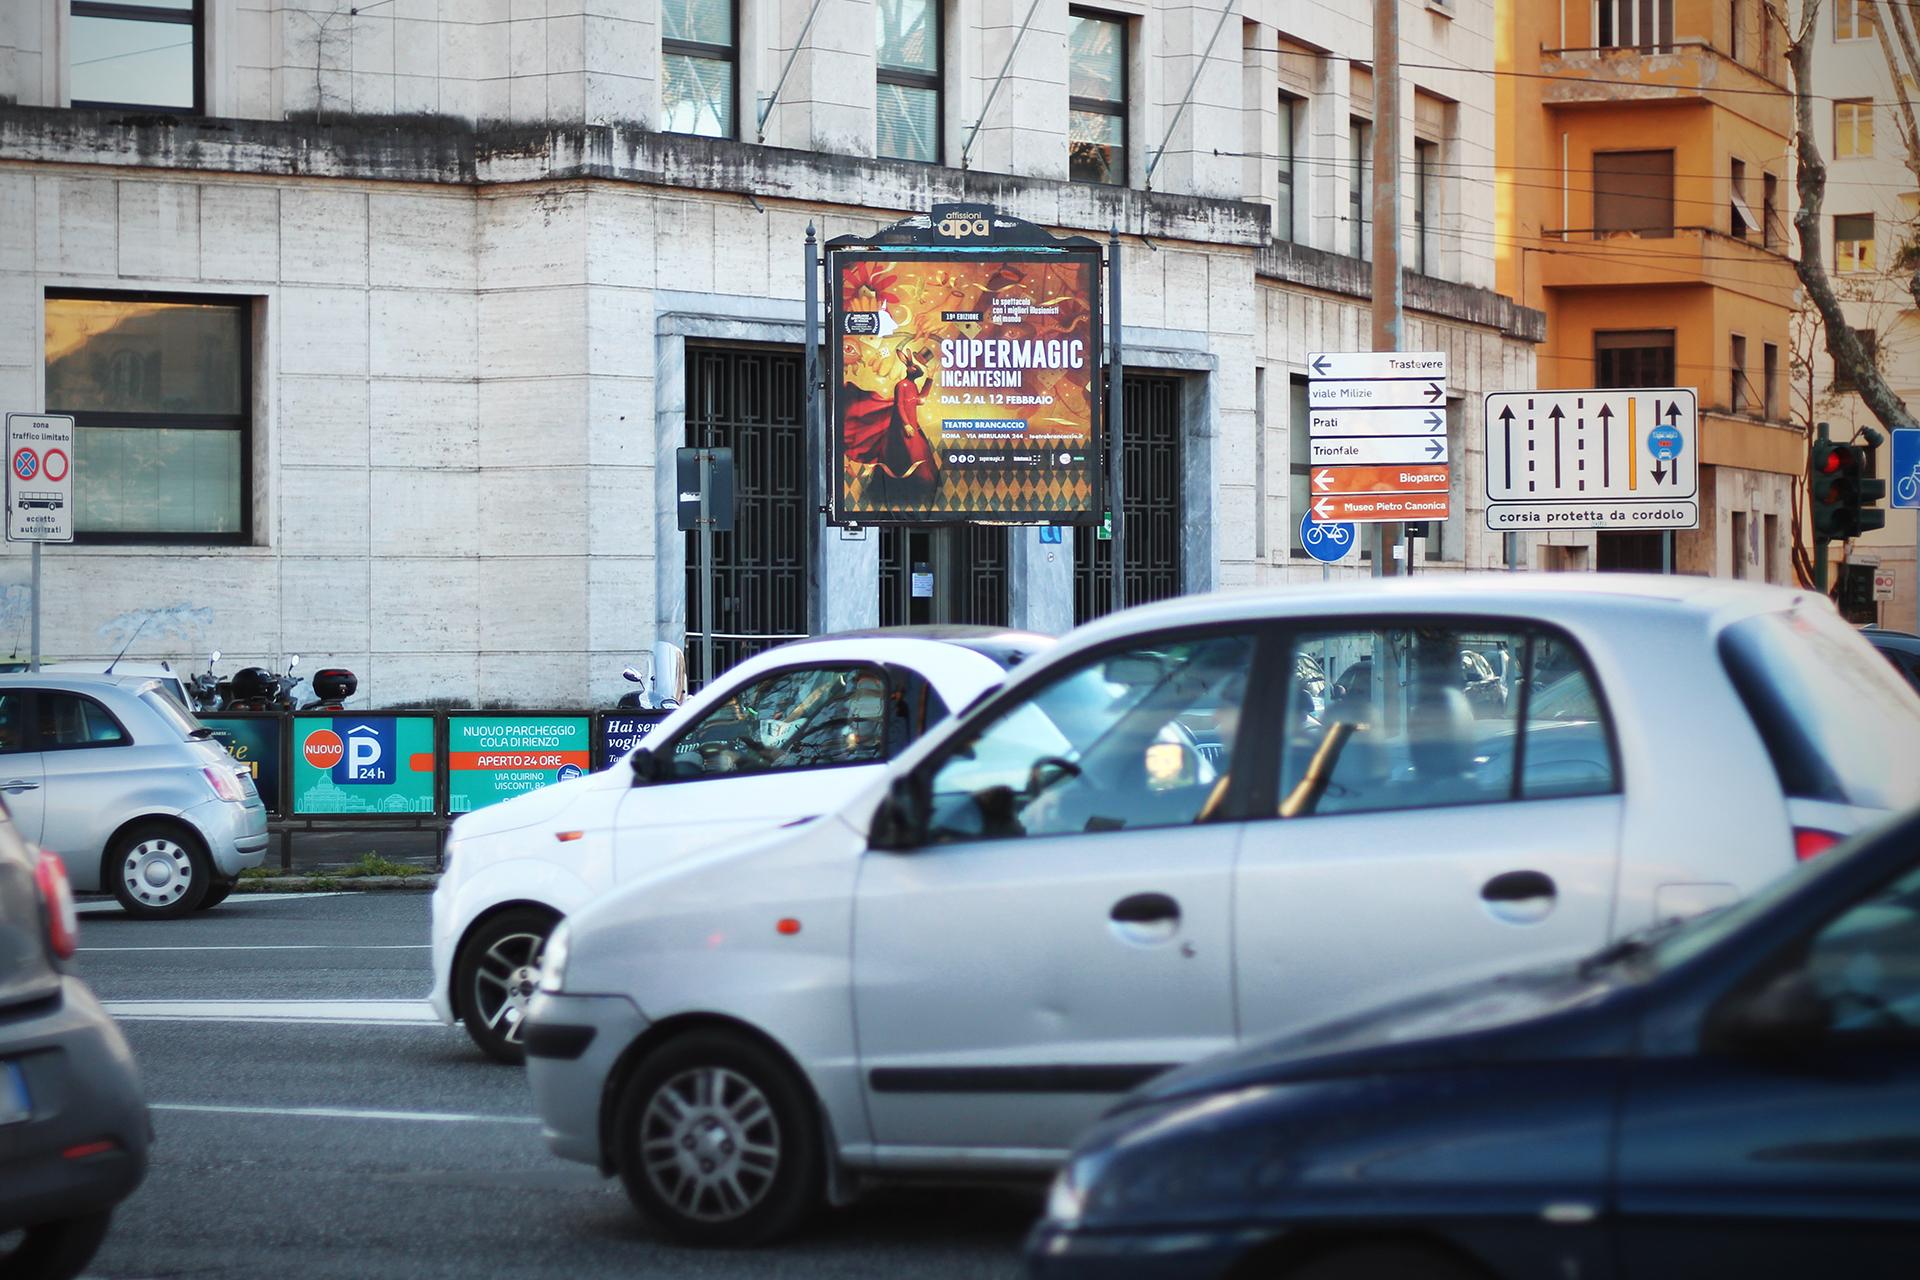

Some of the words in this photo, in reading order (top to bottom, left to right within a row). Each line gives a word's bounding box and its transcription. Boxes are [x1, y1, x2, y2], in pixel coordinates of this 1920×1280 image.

[945, 211, 982, 220] affissioni
[938, 219, 990, 240] apa
[956, 313, 979, 321] EDIZIONE
[941, 339, 1084, 369] SUPERMAGIC
[1389, 359, 1444, 369] Trastevere
[941, 370, 1022, 388] INCANTESIMI
[1312, 388, 1337, 398] viale
[1340, 388, 1373, 398] Milizie
[941, 395, 961, 405] DAL
[963, 393, 971, 405] 2
[974, 395, 986, 405] AL
[989, 393, 1004, 405] 12
[1006, 395, 1054, 405] FEBBRAIO
[944, 421, 973, 429] TEATRO
[975, 421, 1025, 429] BRANCACCIO
[1313, 417, 1338, 428] Prati
[12, 432, 40, 440] traffico
[41, 433, 70, 442] limitato
[1313, 446, 1359, 456] Trionfale
[1399, 473, 1446, 484] Bioparco
[1344, 502, 1374, 512] Museo
[1376, 501, 1403, 511] Pietro
[1404, 500, 1446, 511] Canonica
[26, 515, 56, 523] eccetto
[1500, 511, 1541, 522] corsia
[1546, 510, 1604, 523] protetta
[1609, 509, 1626, 520] da
[1632, 508, 1685, 520] cordolo
[20, 525, 62, 534] autorizzati
[463, 726, 504, 736] NUOVO
[506, 725, 576, 736] PARCHEGGIO
[607, 720, 634, 733] Hai
[480, 738, 508, 748] COLA
[510, 738, 522, 747] DI
[523, 737, 560, 747] RIENZO
[305, 744, 342, 754] NUOVO
[348, 736, 382, 779] P
[478, 755, 523, 766] APERTO
[524, 755, 538, 766] 24
[540, 755, 562, 766] ORE
[359, 767, 376, 779] 24
[377, 766, 386, 779] h
[494, 772, 510, 780] VIA
[511, 772, 544, 781] QUIRINO
